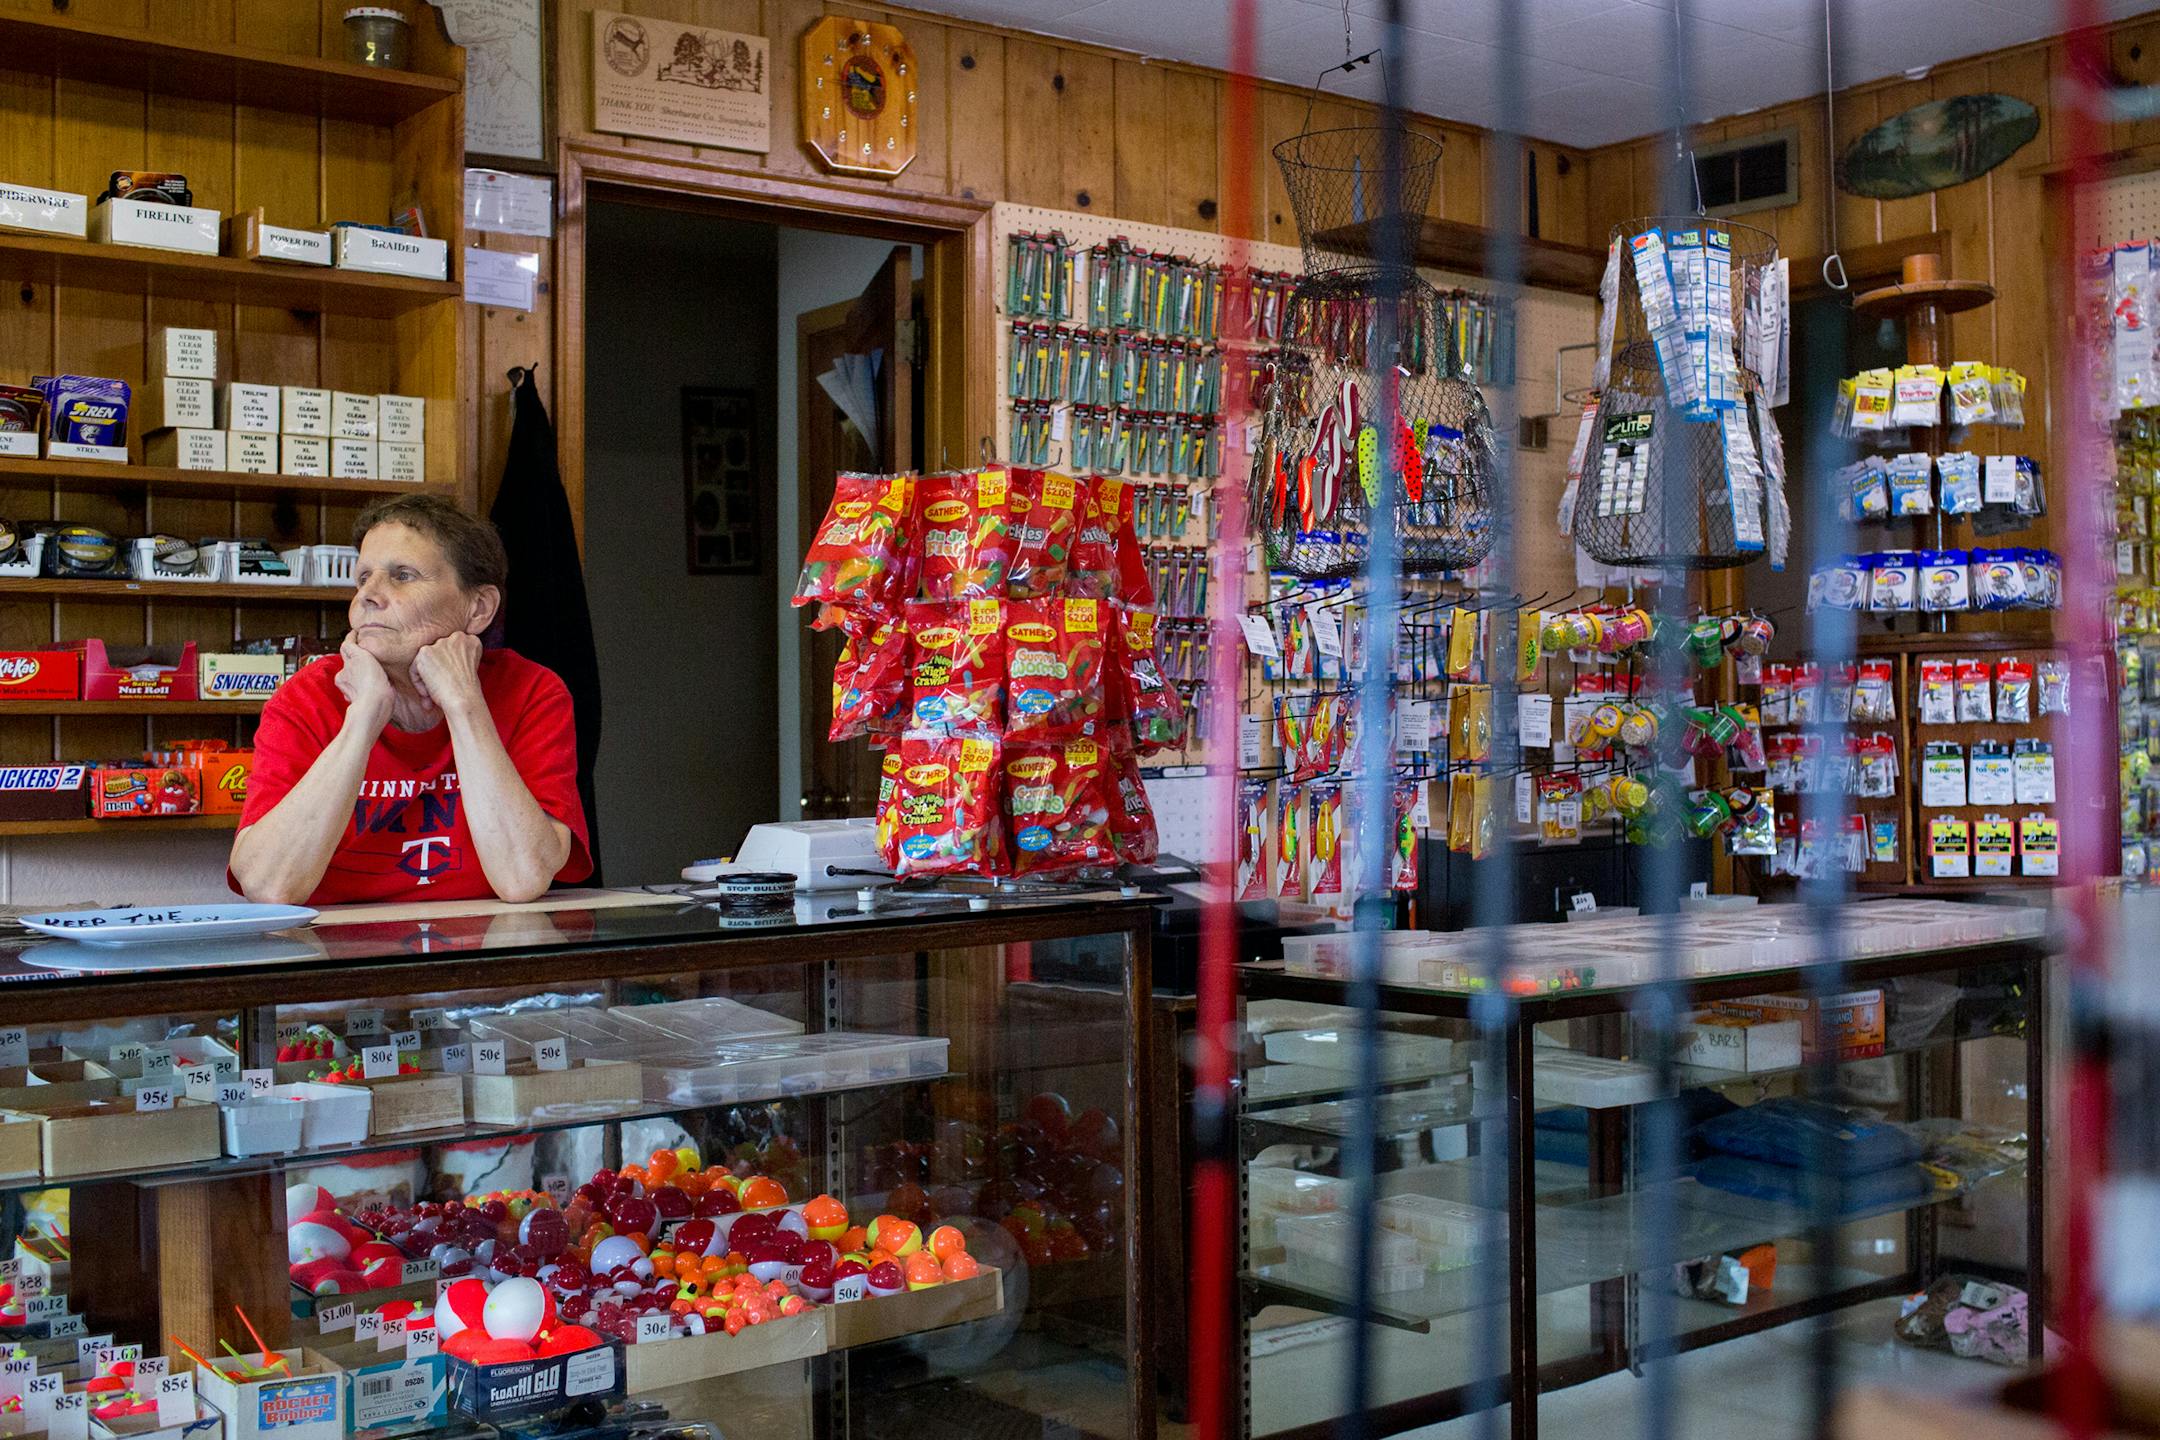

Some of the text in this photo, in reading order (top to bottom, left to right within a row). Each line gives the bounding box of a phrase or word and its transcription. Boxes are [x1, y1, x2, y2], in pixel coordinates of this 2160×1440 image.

[136, 207, 194, 225] FIRELINE
[302, 238, 320, 249] PRO
[371, 238, 421, 254] BRAIDED
[69, 401, 118, 419] STREN
[75, 446, 101, 454] STREN
[1045, 488, 1072, 498] $2.00
[927, 505, 966, 518] SATHERS
[1067, 613, 1094, 624] $2.00
[1011, 627, 1053, 639] SATHERS
[213, 674, 280, 690] SNICKERS
[118, 686, 170, 695] Nut Roll
[62, 768, 80, 781] 2
[726, 883, 795, 892] STOP BULLYING
[120, 909, 184, 924] THE
[1708, 1032, 1741, 1049] BARS
[371, 1049, 394, 1064] 80¢
[445, 1047, 466, 1060] 50¢
[479, 1048, 501, 1061] 50¢
[540, 1046, 561, 1060] 50¢
[187, 1071, 212, 1086] 75¢
[143, 1091, 169, 1105] 95¢
[221, 1088, 247, 1102] 30¢
[838, 1288, 860, 1301] 50¢
[322, 1303, 352, 1323] $1.00
[360, 1317, 380, 1330] 95¢
[384, 1321, 402, 1336] 95¢
[644, 1321, 668, 1336] 30¢
[413, 1330, 436, 1345] 95¢
[82, 1340, 108, 1355] 95¢
[5, 1360, 31, 1376] 90¢
[138, 1359, 164, 1376] 85¢
[490, 1363, 535, 1377] FLUORESCENT
[29, 1376, 57, 1393] 85¢
[162, 1377, 189, 1394] 85¢
[534, 1363, 561, 1394] GLO
[55, 1393, 83, 1411] 85¢
[262, 1393, 331, 1412] ROCKET
[264, 1408, 327, 1424] Bobber
